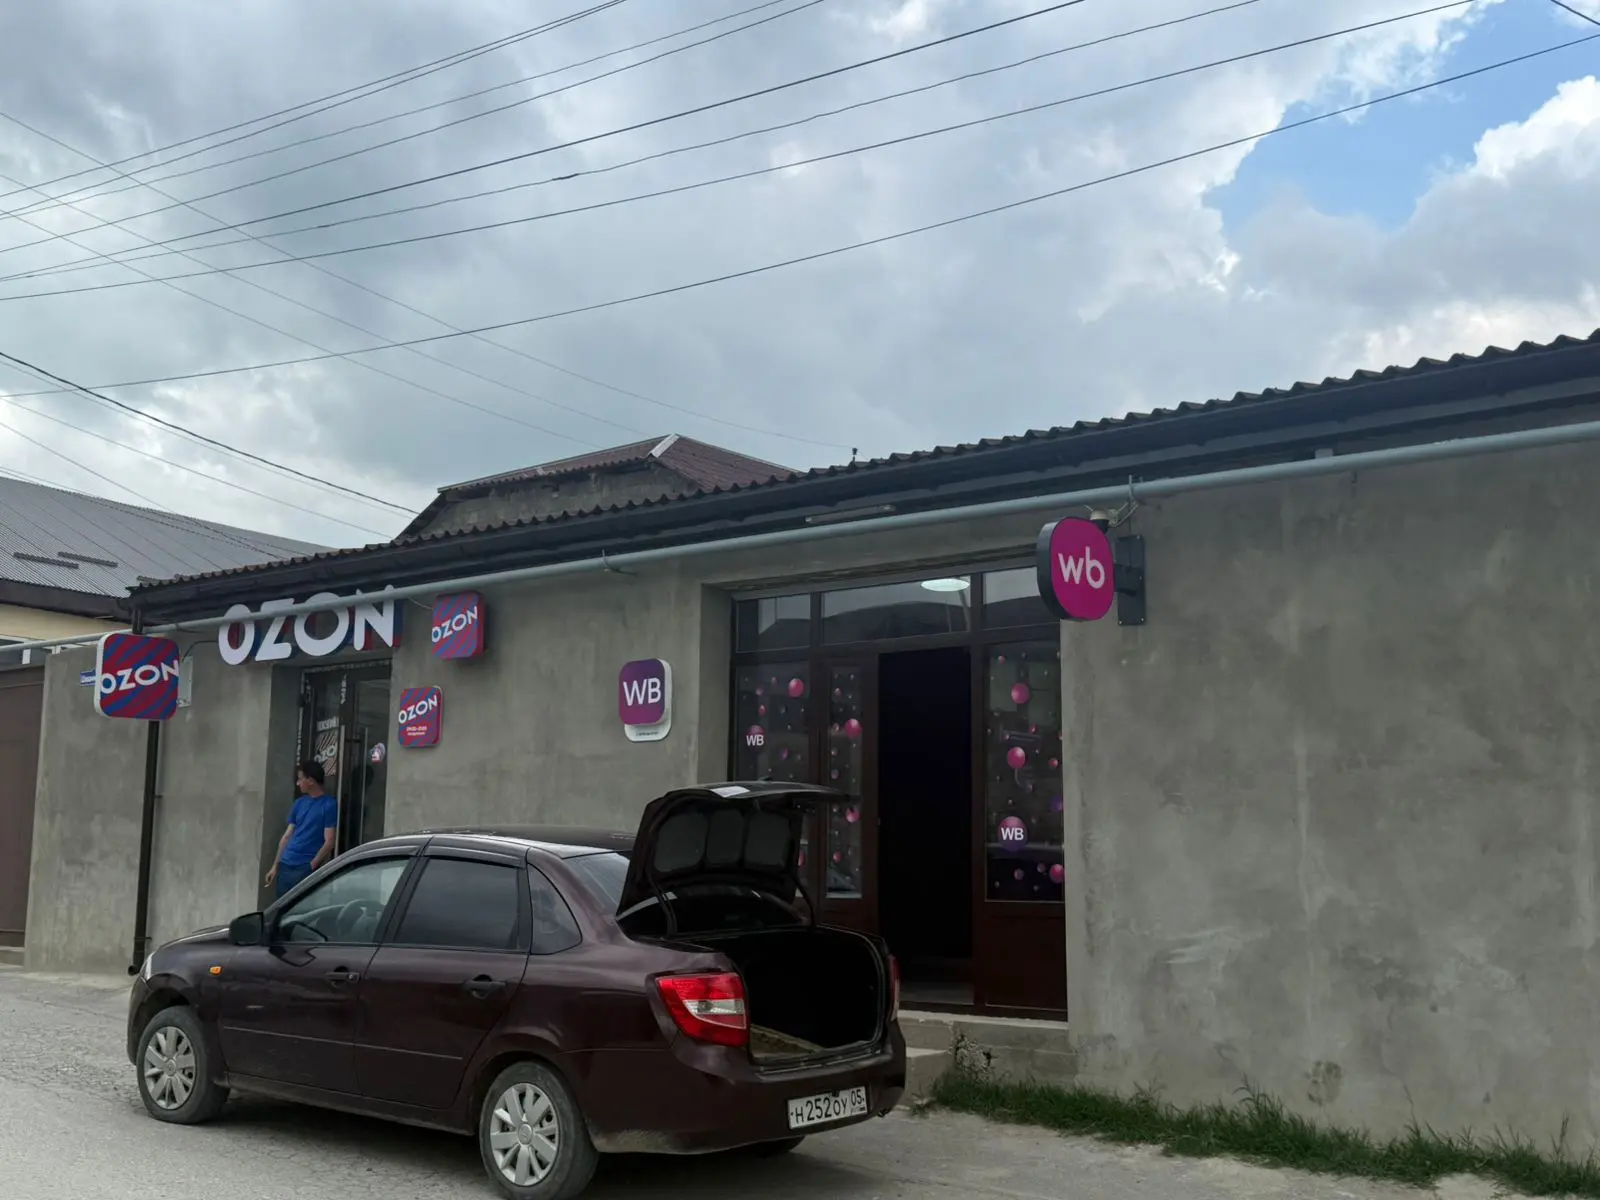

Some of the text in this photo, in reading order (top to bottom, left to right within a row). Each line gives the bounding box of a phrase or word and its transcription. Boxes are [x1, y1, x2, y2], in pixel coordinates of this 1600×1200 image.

[1058, 546, 1106, 589] wb
[218, 584, 395, 665] OZON
[432, 605, 478, 643] OZON
[100, 659, 179, 694] OZON
[622, 677, 661, 706] WB
[398, 694, 438, 724] OZON
[746, 734, 764, 746] WB
[1001, 827, 1024, 841] WB
